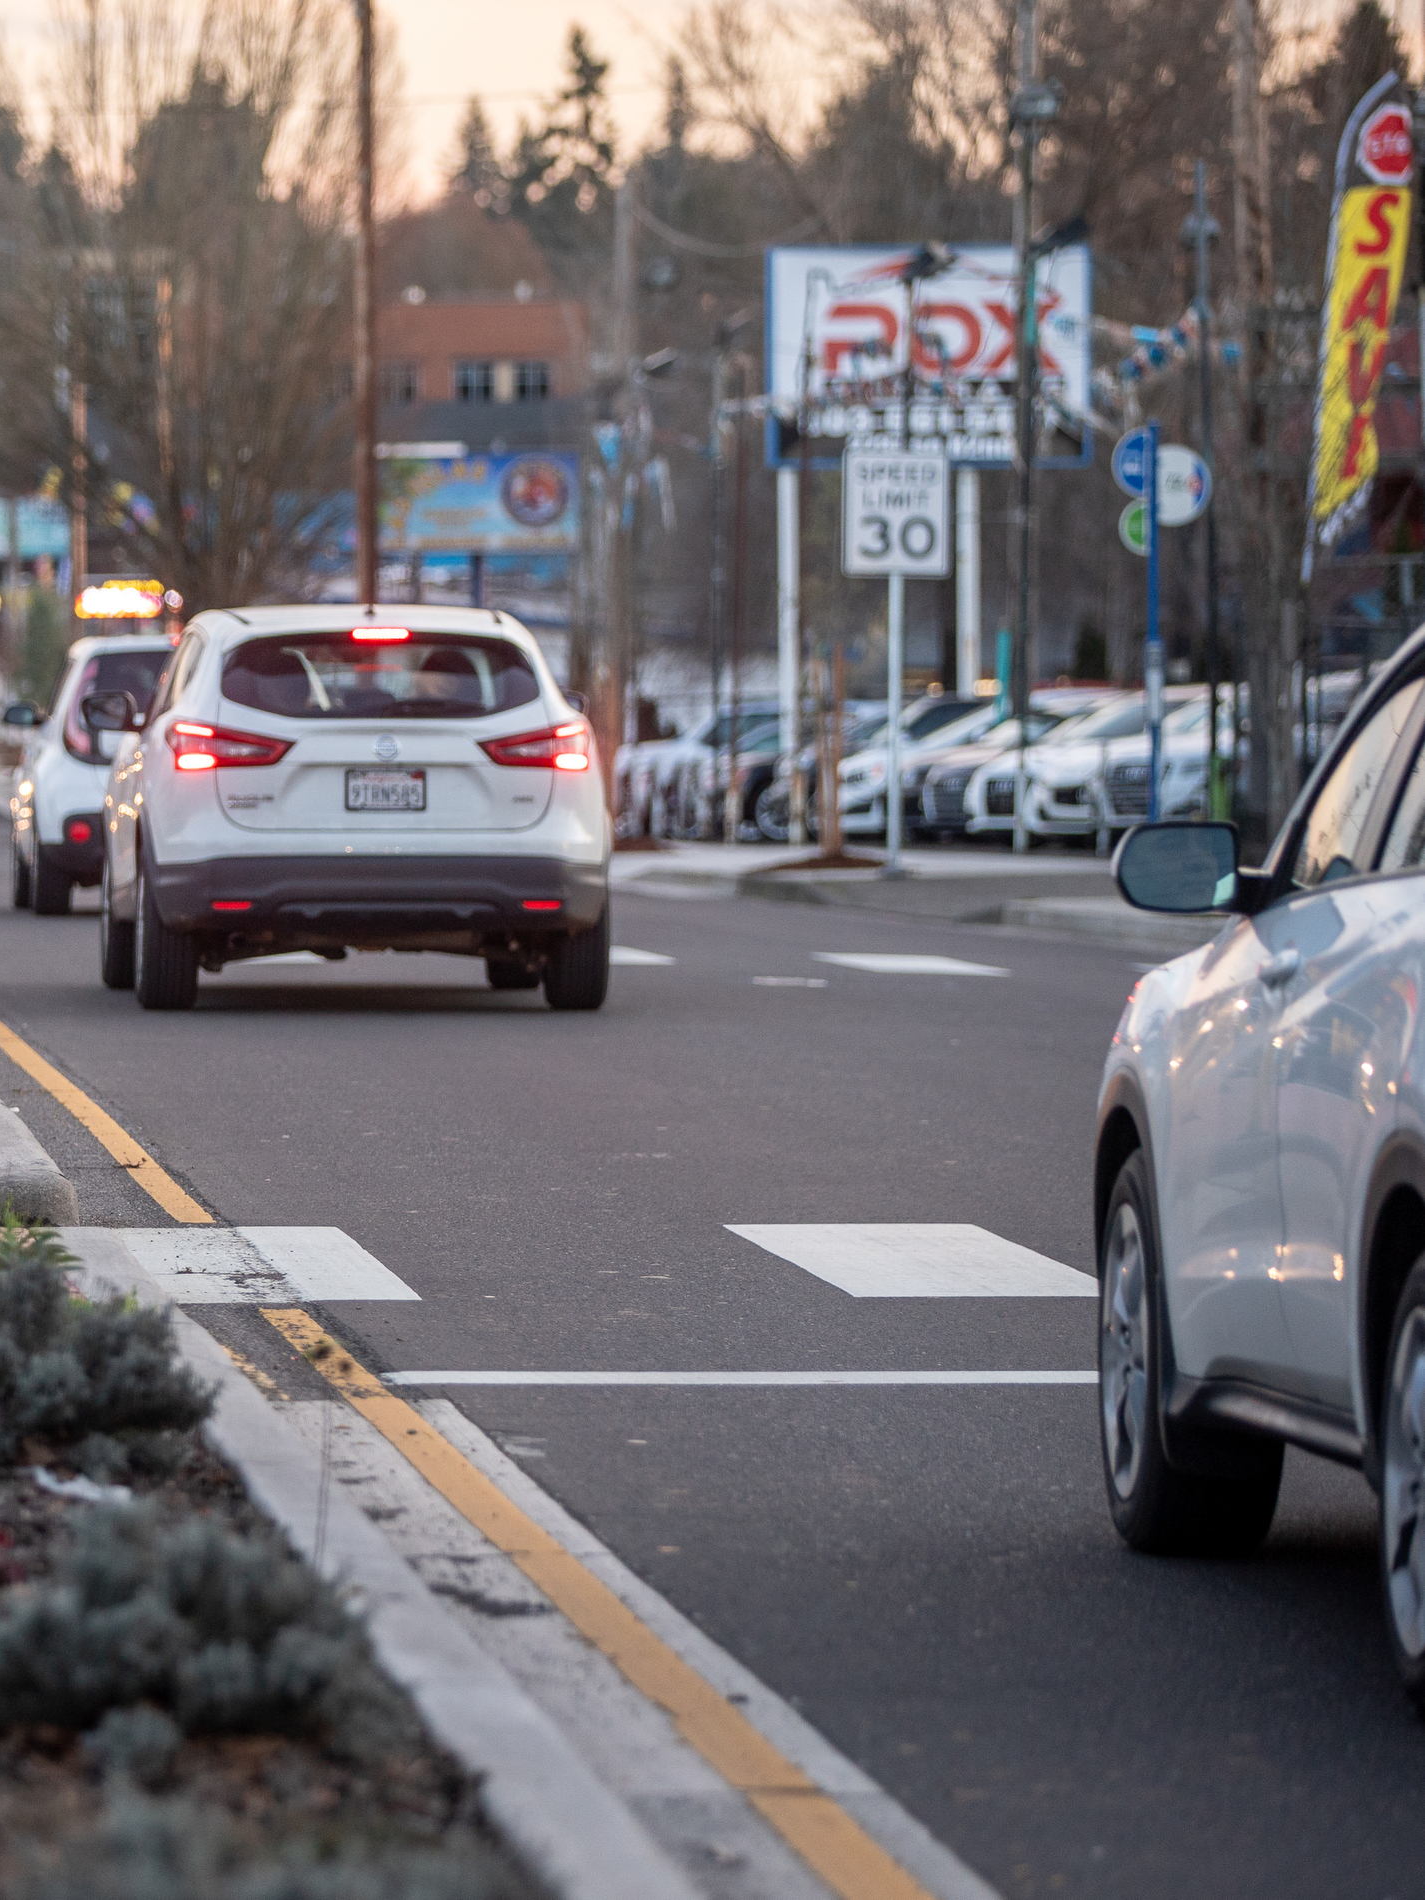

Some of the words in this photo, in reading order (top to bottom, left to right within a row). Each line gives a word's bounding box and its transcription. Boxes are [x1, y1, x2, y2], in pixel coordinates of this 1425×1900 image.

[856, 462, 937, 482] SPEED
[861, 487, 929, 508] LIMIT
[858, 515, 936, 559] 30
